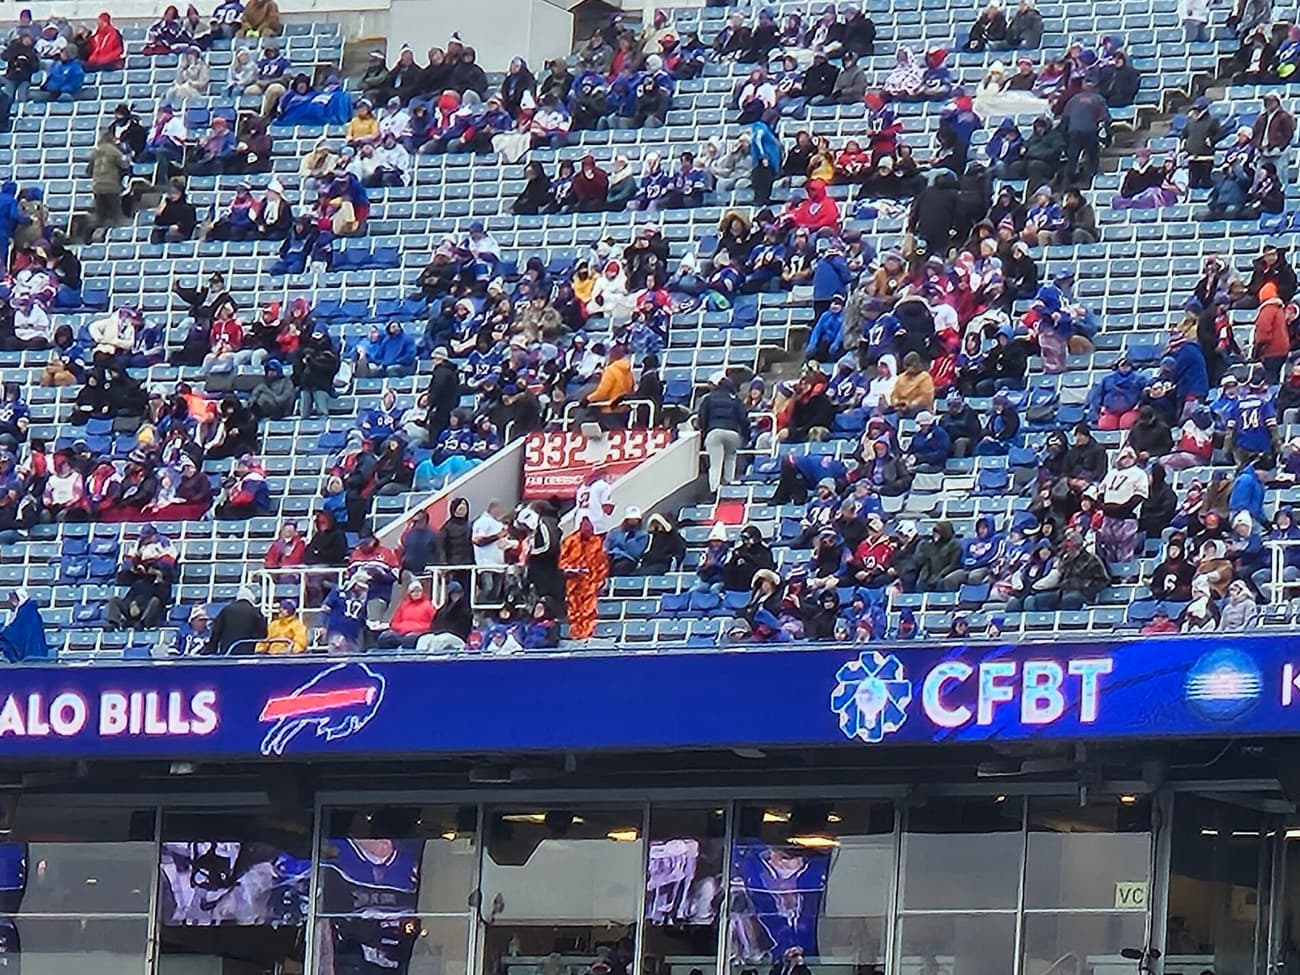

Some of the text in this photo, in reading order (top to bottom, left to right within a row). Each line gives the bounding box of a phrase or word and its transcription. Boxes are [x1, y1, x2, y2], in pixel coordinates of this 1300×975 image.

[868, 325, 885, 345] 17
[1240, 408, 1259, 429] 14
[1107, 473, 1128, 491] 17
[344, 599, 362, 620] 17
[922, 657, 1113, 729] CFBT
[0, 690, 219, 736] ALO BILLS
[1119, 887, 1144, 905] VC
